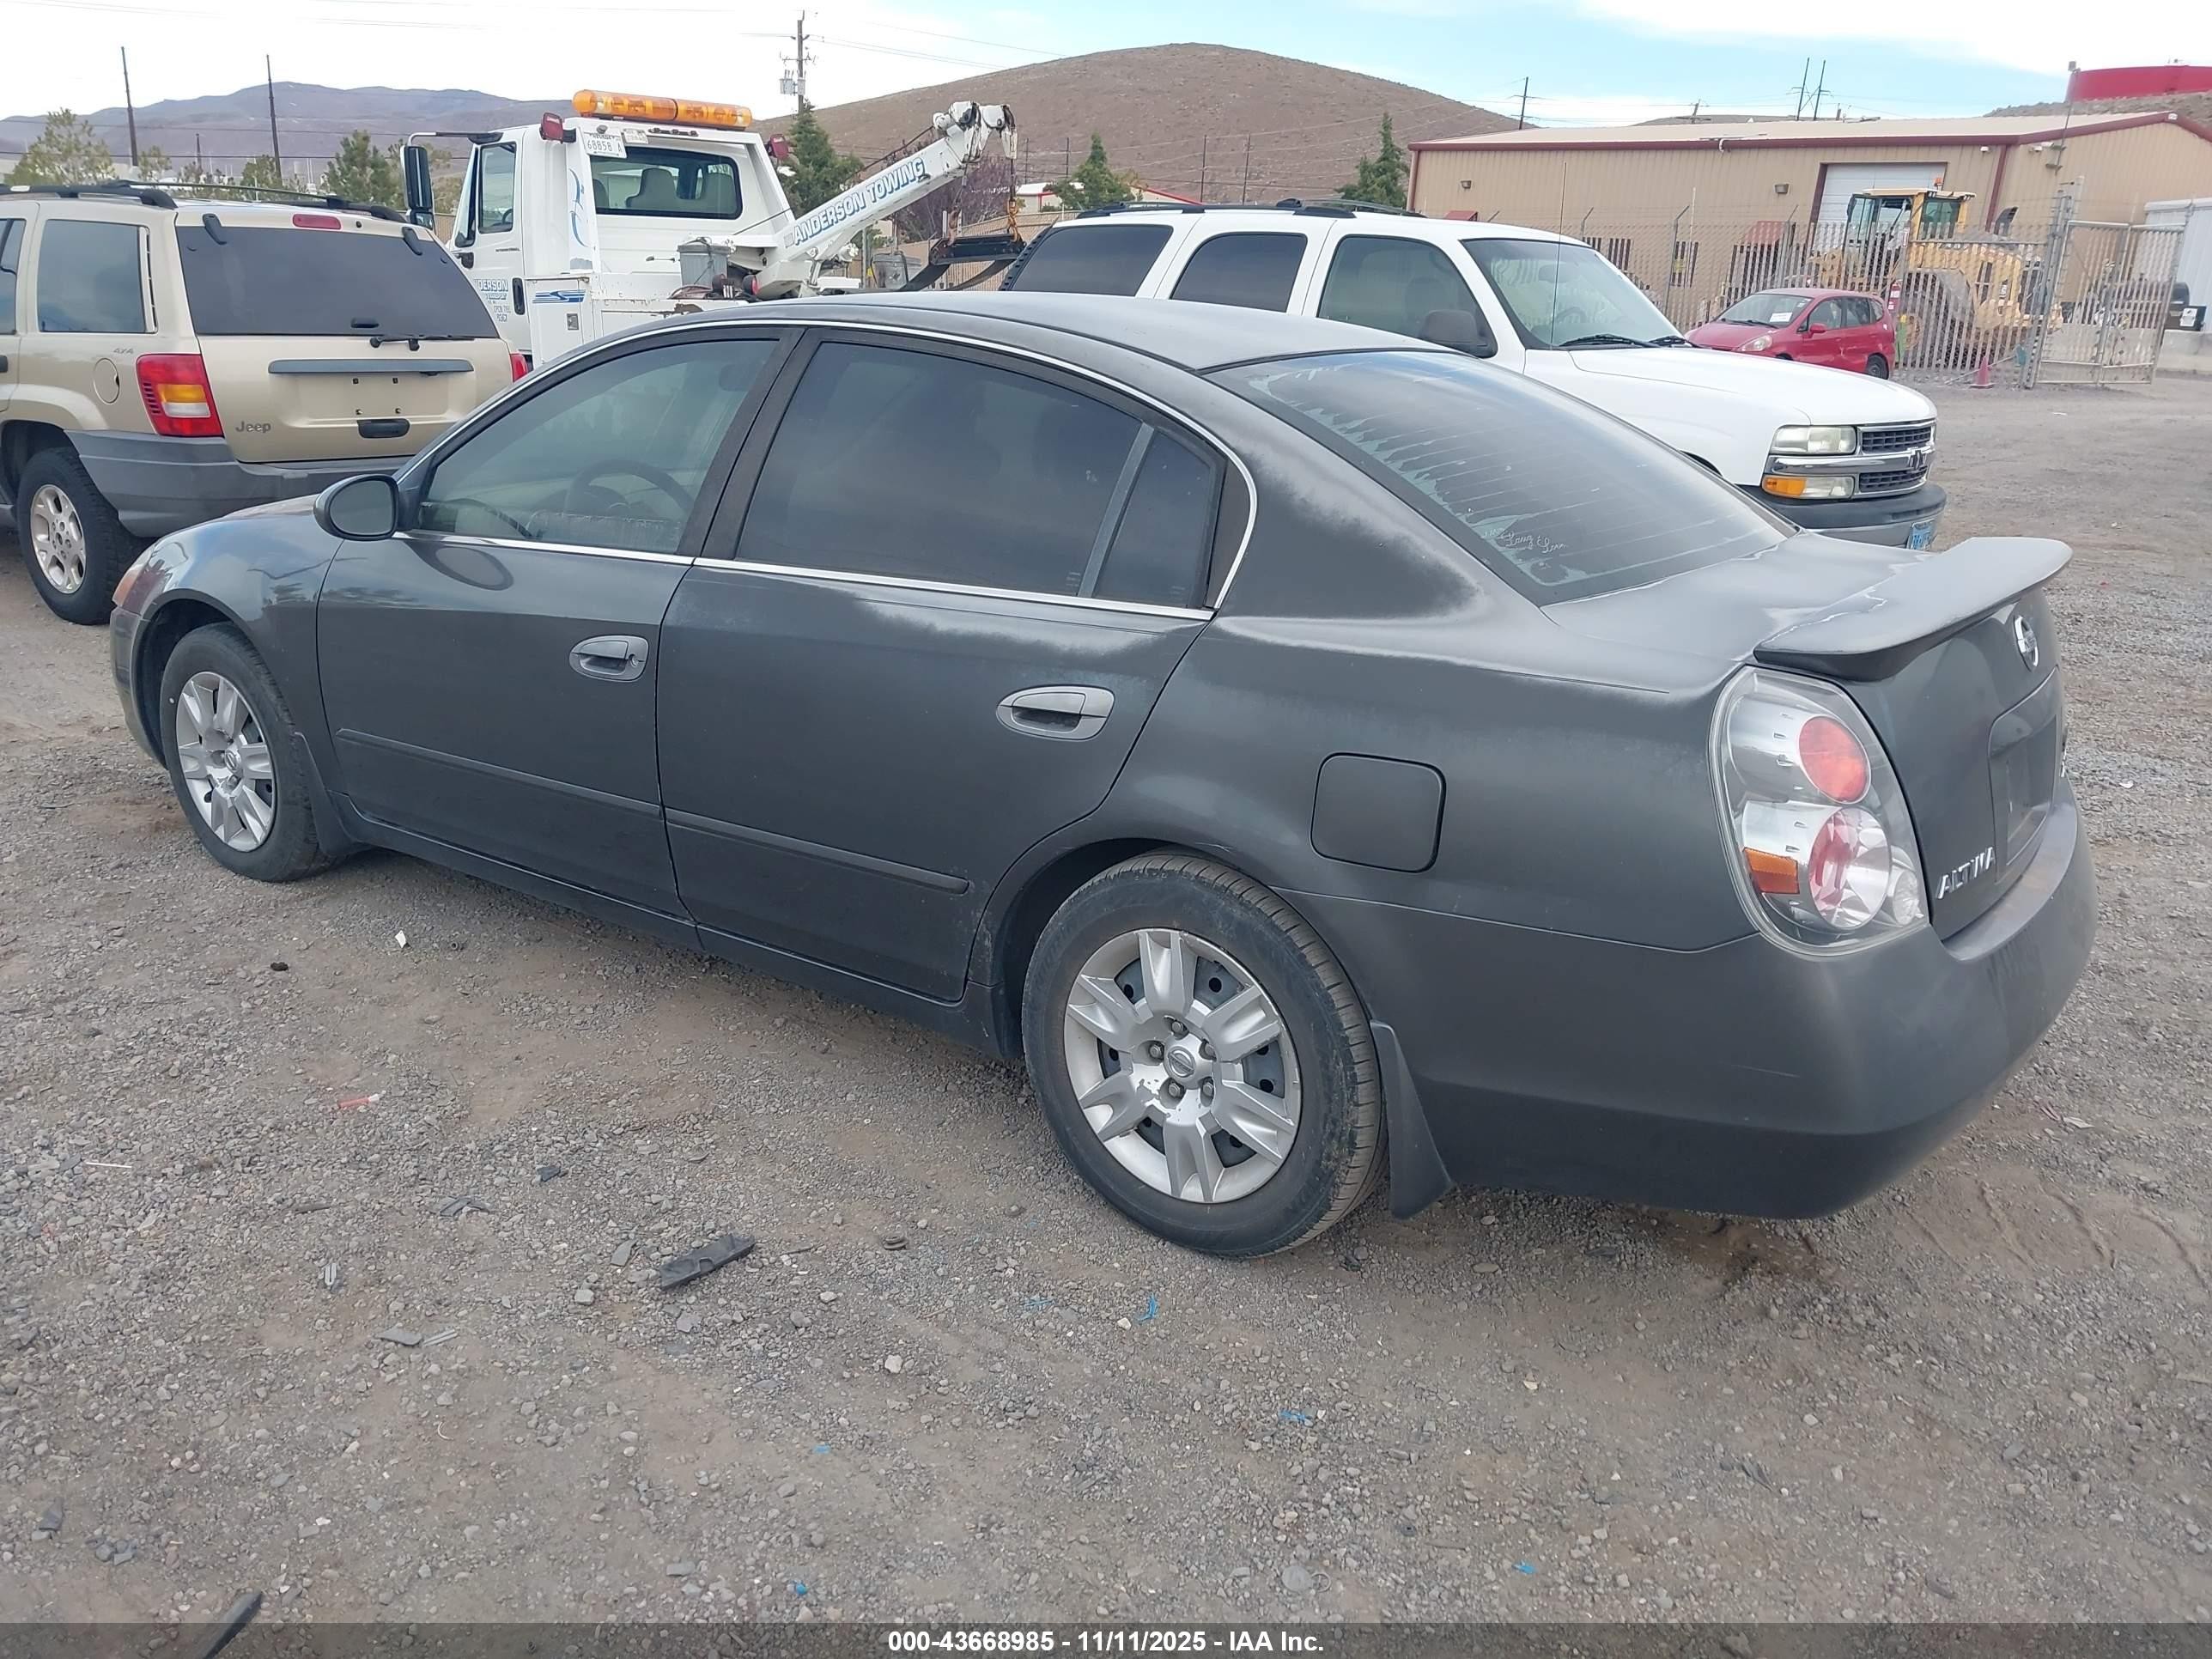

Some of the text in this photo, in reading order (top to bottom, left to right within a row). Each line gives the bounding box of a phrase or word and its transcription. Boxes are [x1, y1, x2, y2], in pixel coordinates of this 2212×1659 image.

[793, 156, 926, 246] ANDERSON TOWING
[477, 279, 509, 292] DERSON
[235, 420, 271, 434] Jeep
